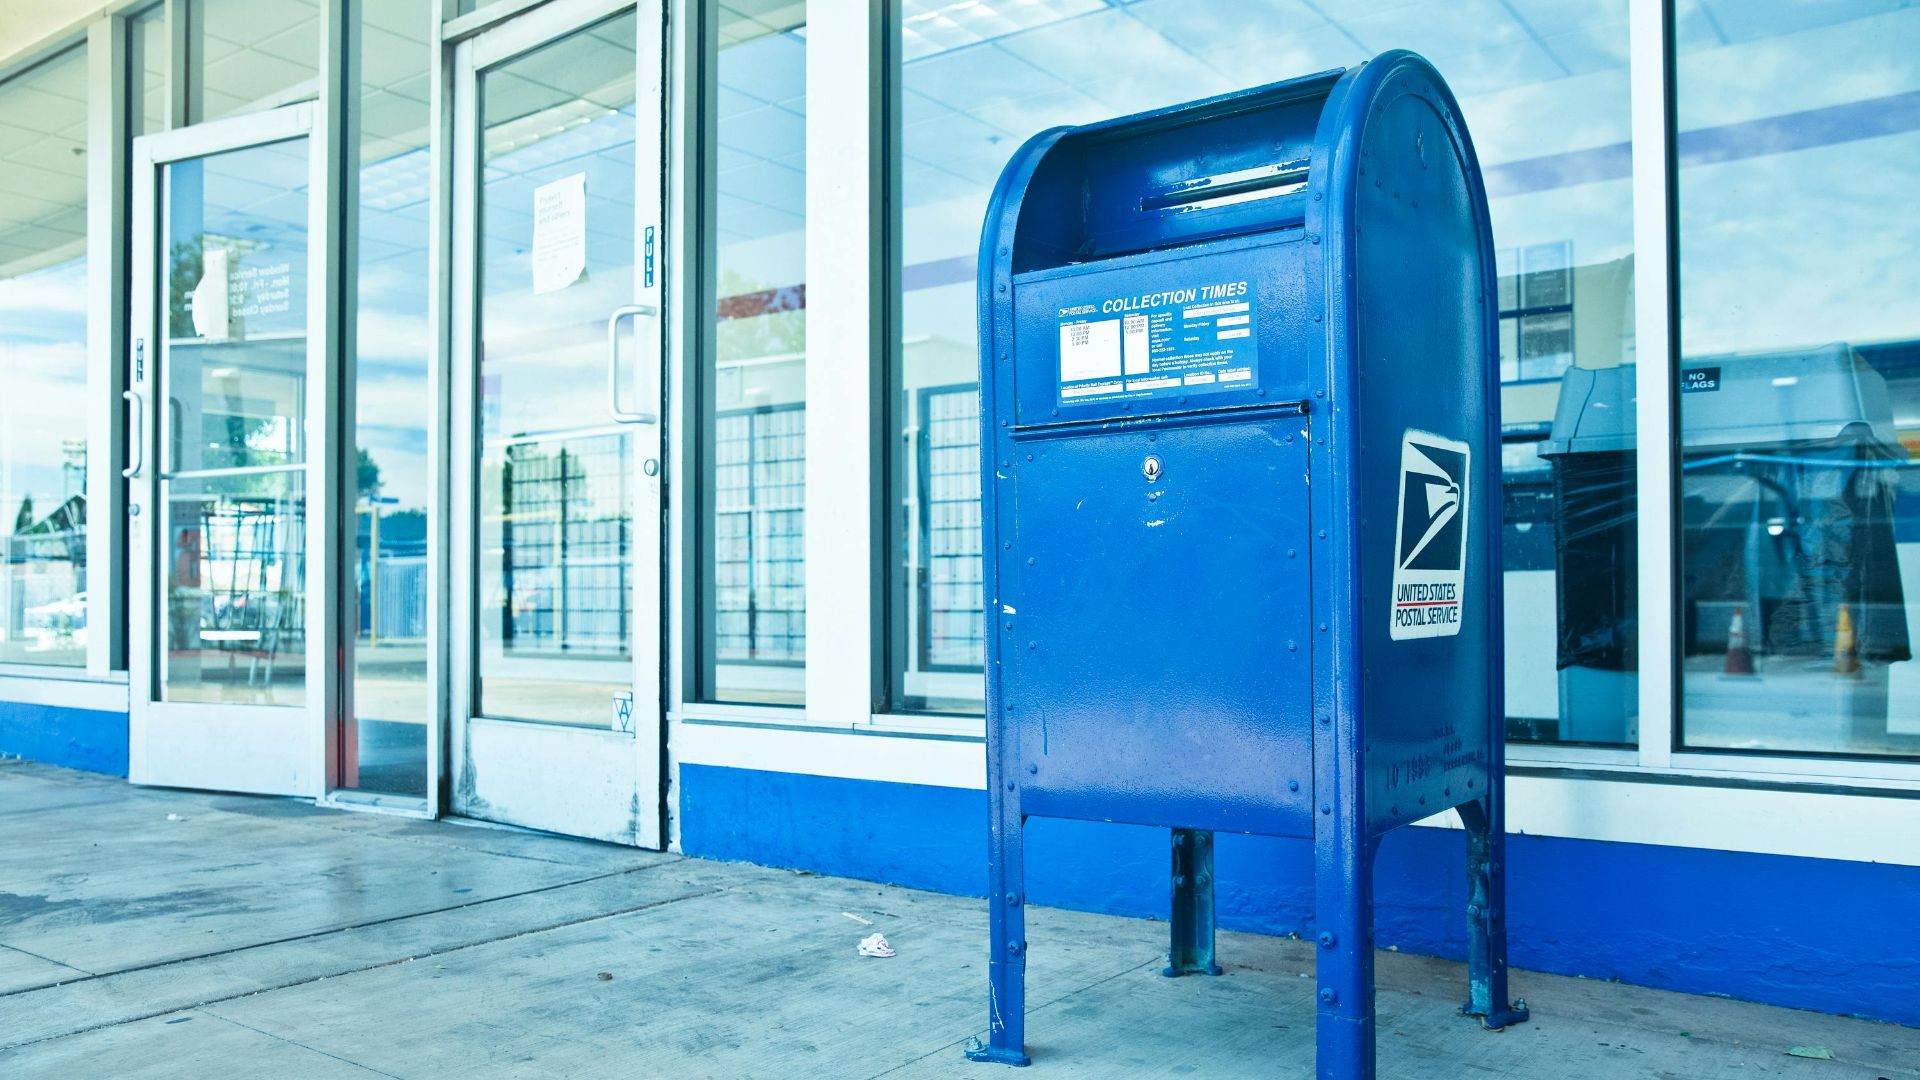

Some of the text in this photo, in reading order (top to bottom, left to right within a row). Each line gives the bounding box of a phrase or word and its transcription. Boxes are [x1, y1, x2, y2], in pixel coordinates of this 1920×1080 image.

[1102, 288, 1196, 314] COLLECTION
[1202, 281, 1248, 300] TIMES
[1397, 583, 1456, 602] UNITED STATES
[1396, 606, 1458, 627] POSTAL SERVICE
